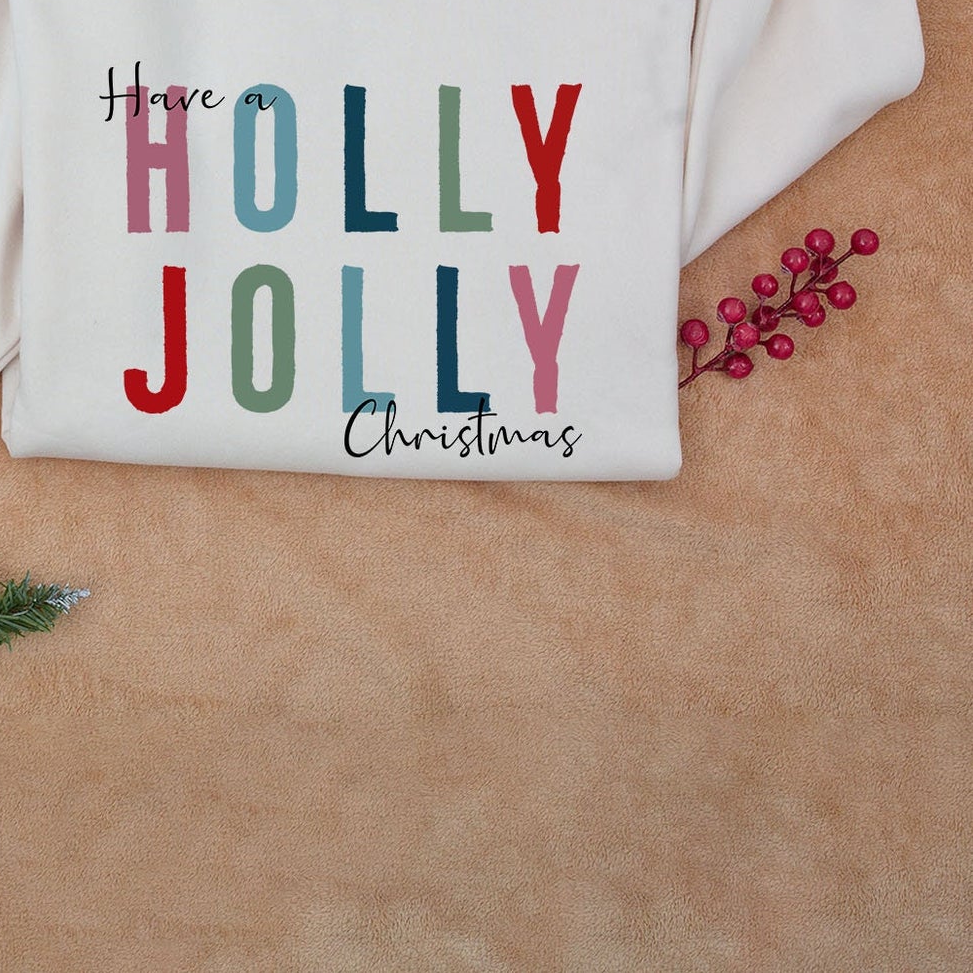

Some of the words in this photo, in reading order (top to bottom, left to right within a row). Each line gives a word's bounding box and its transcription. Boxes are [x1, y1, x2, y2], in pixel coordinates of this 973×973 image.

[99, 61, 225, 121] Have
[244, 91, 277, 112] a
[125, 83, 582, 234] HOLLY
[123, 263, 580, 415] JOLLY
[343, 398, 583, 459] Christmas
